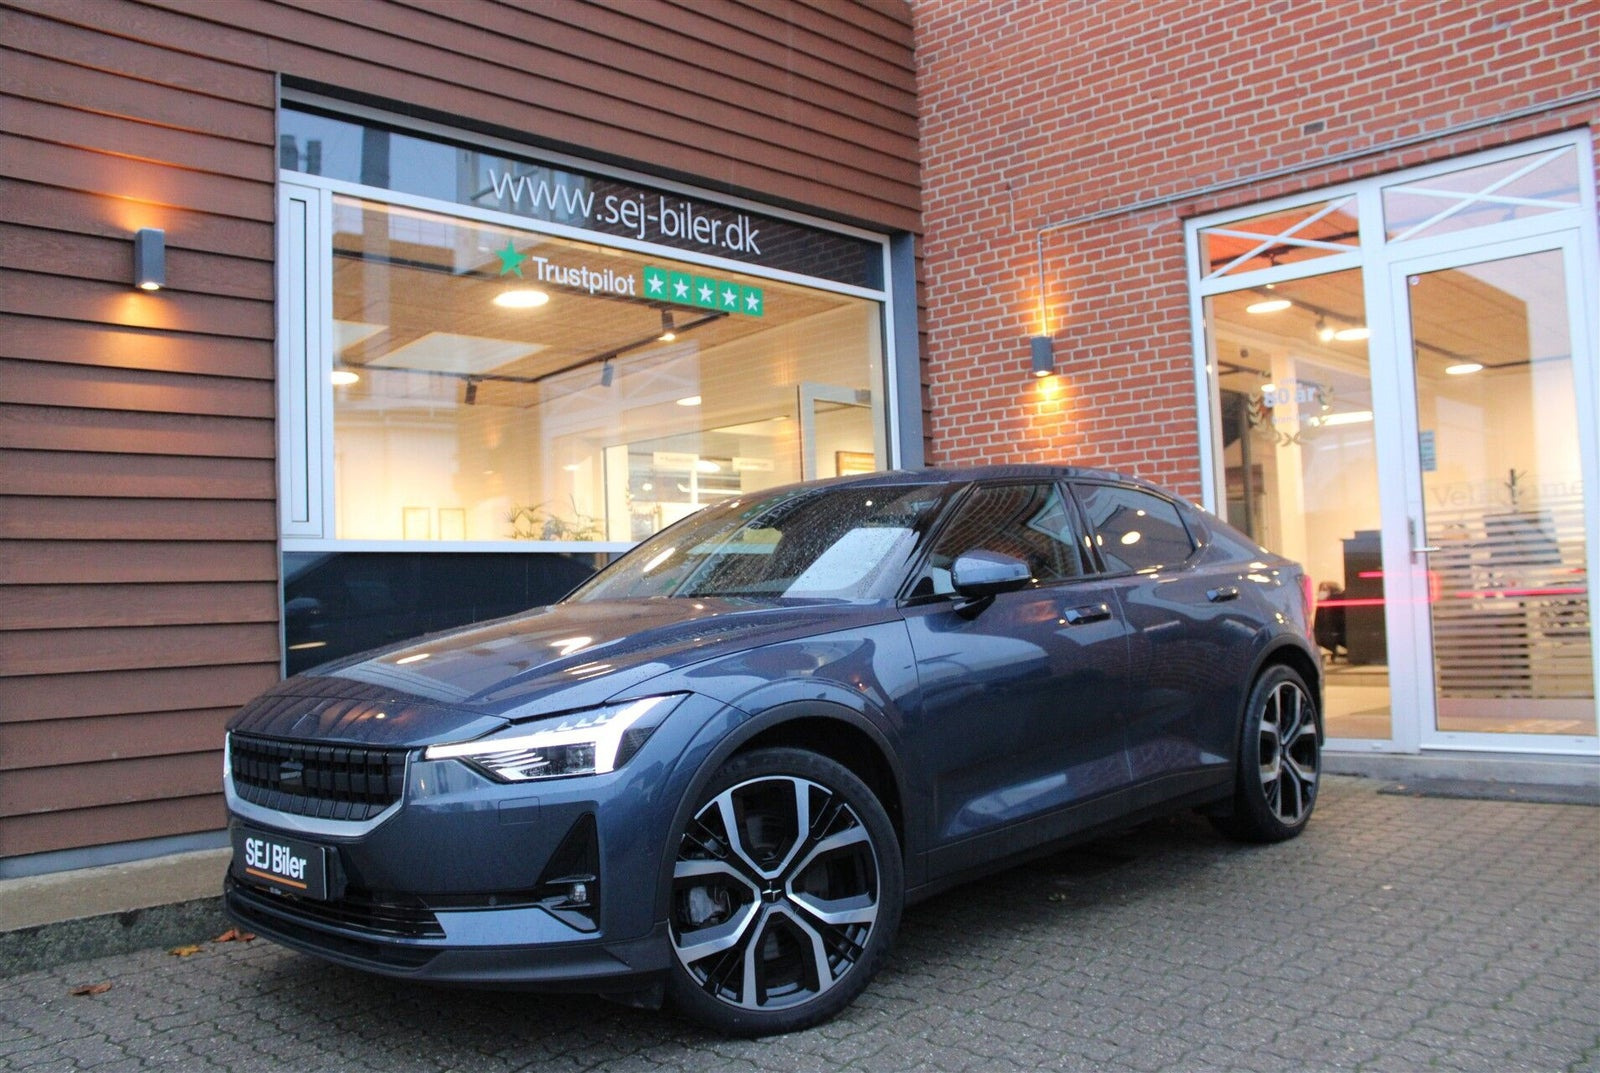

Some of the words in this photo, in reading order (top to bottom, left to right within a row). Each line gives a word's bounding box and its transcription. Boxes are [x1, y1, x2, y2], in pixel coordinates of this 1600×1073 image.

[489, 168, 761, 255] www.sej-biler.dk
[532, 256, 636, 296] Trustpilot
[245, 837, 270, 870] SEJ
[272, 844, 307, 880] Biler
